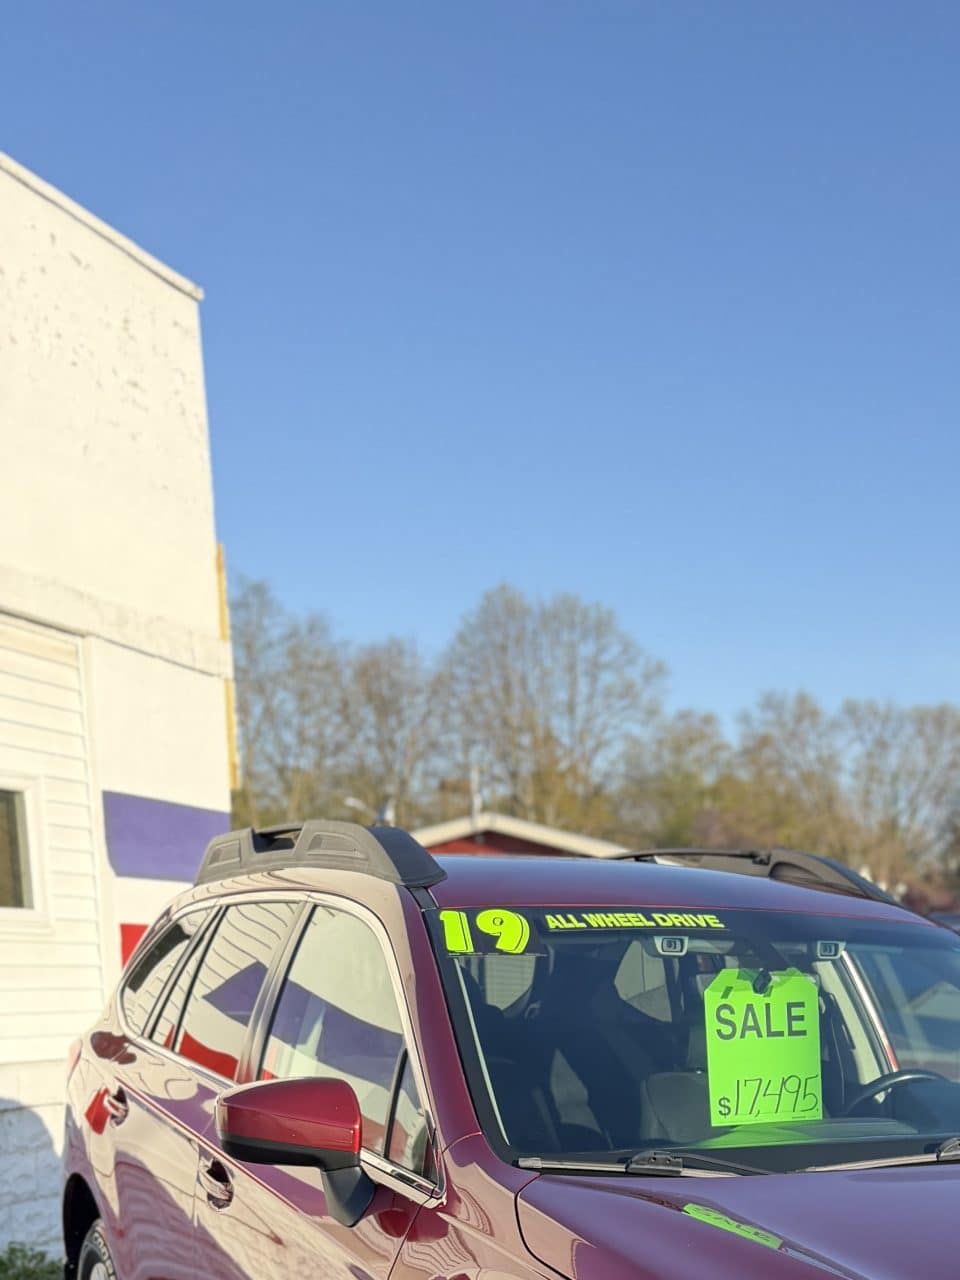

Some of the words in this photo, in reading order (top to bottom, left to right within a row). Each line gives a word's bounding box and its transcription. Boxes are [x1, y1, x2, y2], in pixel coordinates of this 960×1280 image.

[440, 909, 530, 954] 19
[545, 914, 586, 929] ALL
[584, 913, 655, 929] WHEEL
[652, 913, 725, 929] DRIVE
[716, 1001, 807, 1040] SALE
